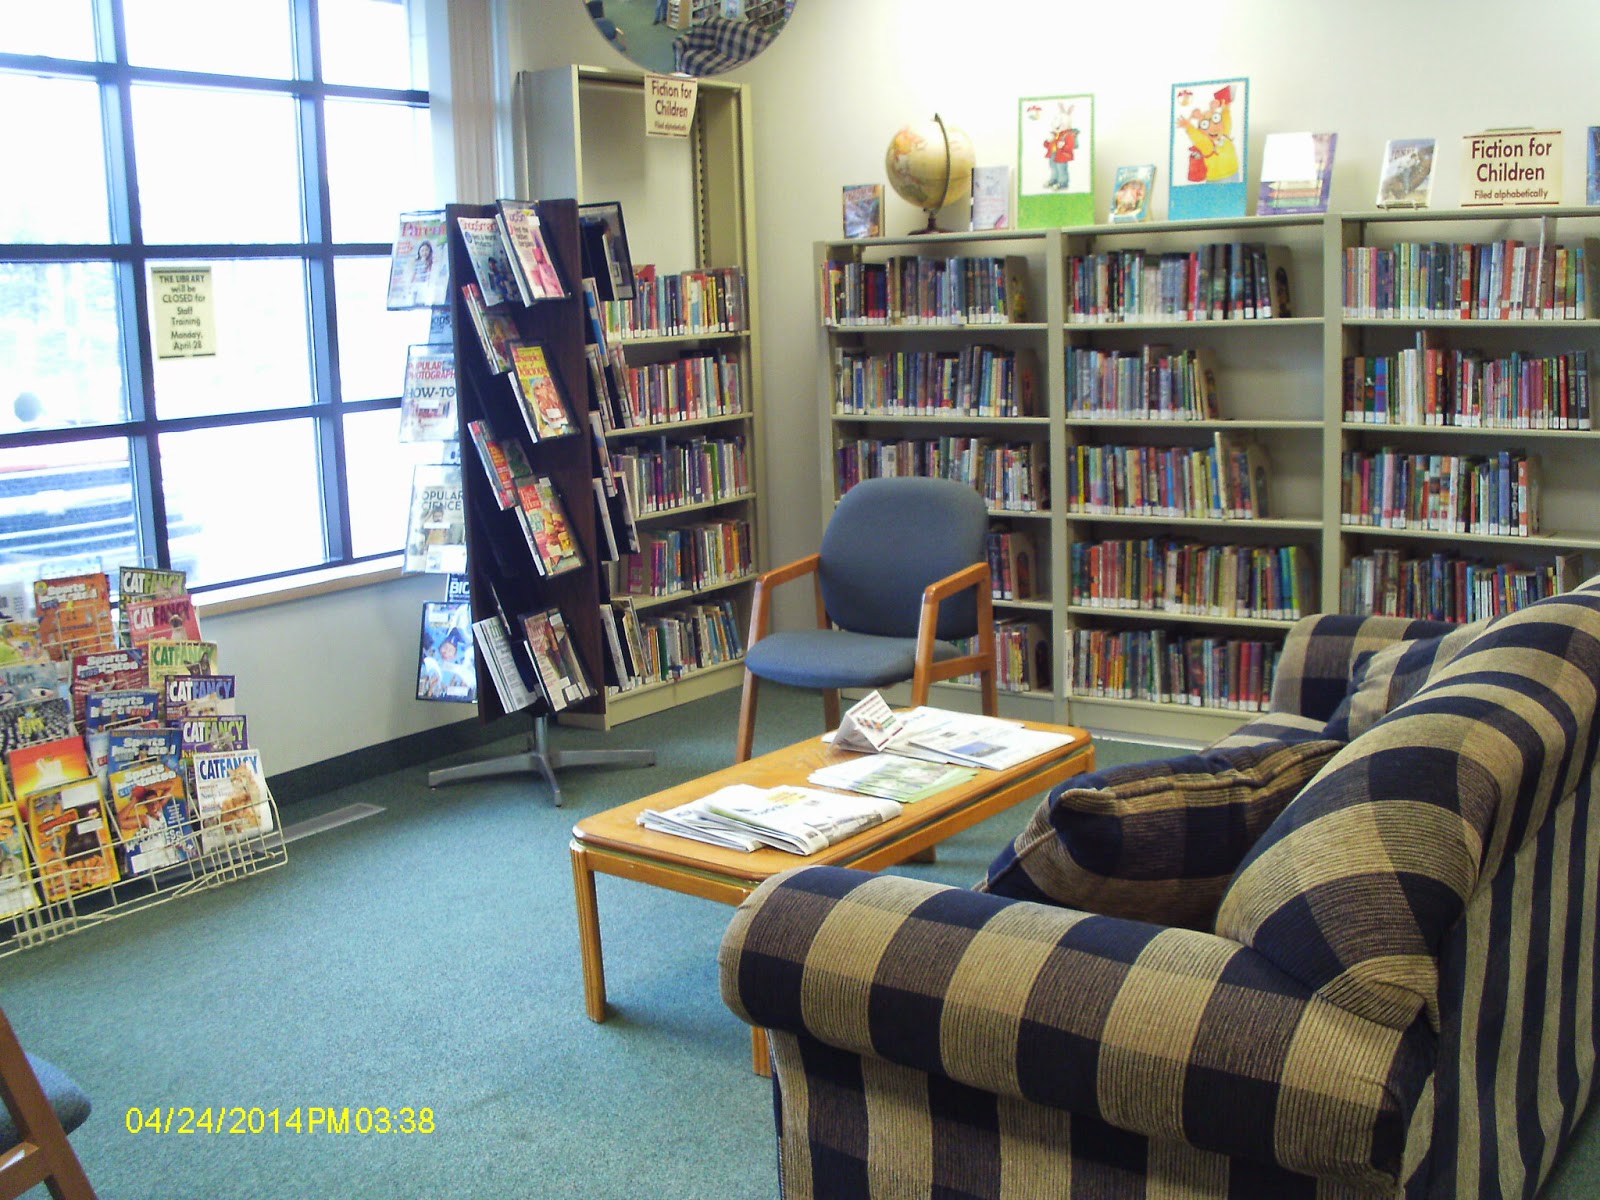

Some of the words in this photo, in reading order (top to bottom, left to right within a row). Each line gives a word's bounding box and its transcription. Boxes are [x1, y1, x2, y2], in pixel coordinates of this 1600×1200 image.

[651, 80, 679, 97] Fiction
[681, 83, 692, 98] for
[655, 99, 688, 118] Children
[1471, 139, 1524, 159] Fiction
[1529, 137, 1552, 156] for
[1476, 162, 1545, 182] Children
[1474, 190, 1492, 199] Filed
[1494, 188, 1548, 201] alphabetically
[159, 275, 174, 283] THE
[176, 275, 205, 283] LIBRARY
[162, 294, 193, 303] CLOSED
[194, 294, 206, 302] for
[177, 306, 193, 315] Staff
[171, 317, 201, 326] Training
[173, 341, 191, 351] April
[408, 361, 443, 371] PPULAR
[420, 490, 463, 501] OPULAR
[420, 501, 462, 511] CIENCE
